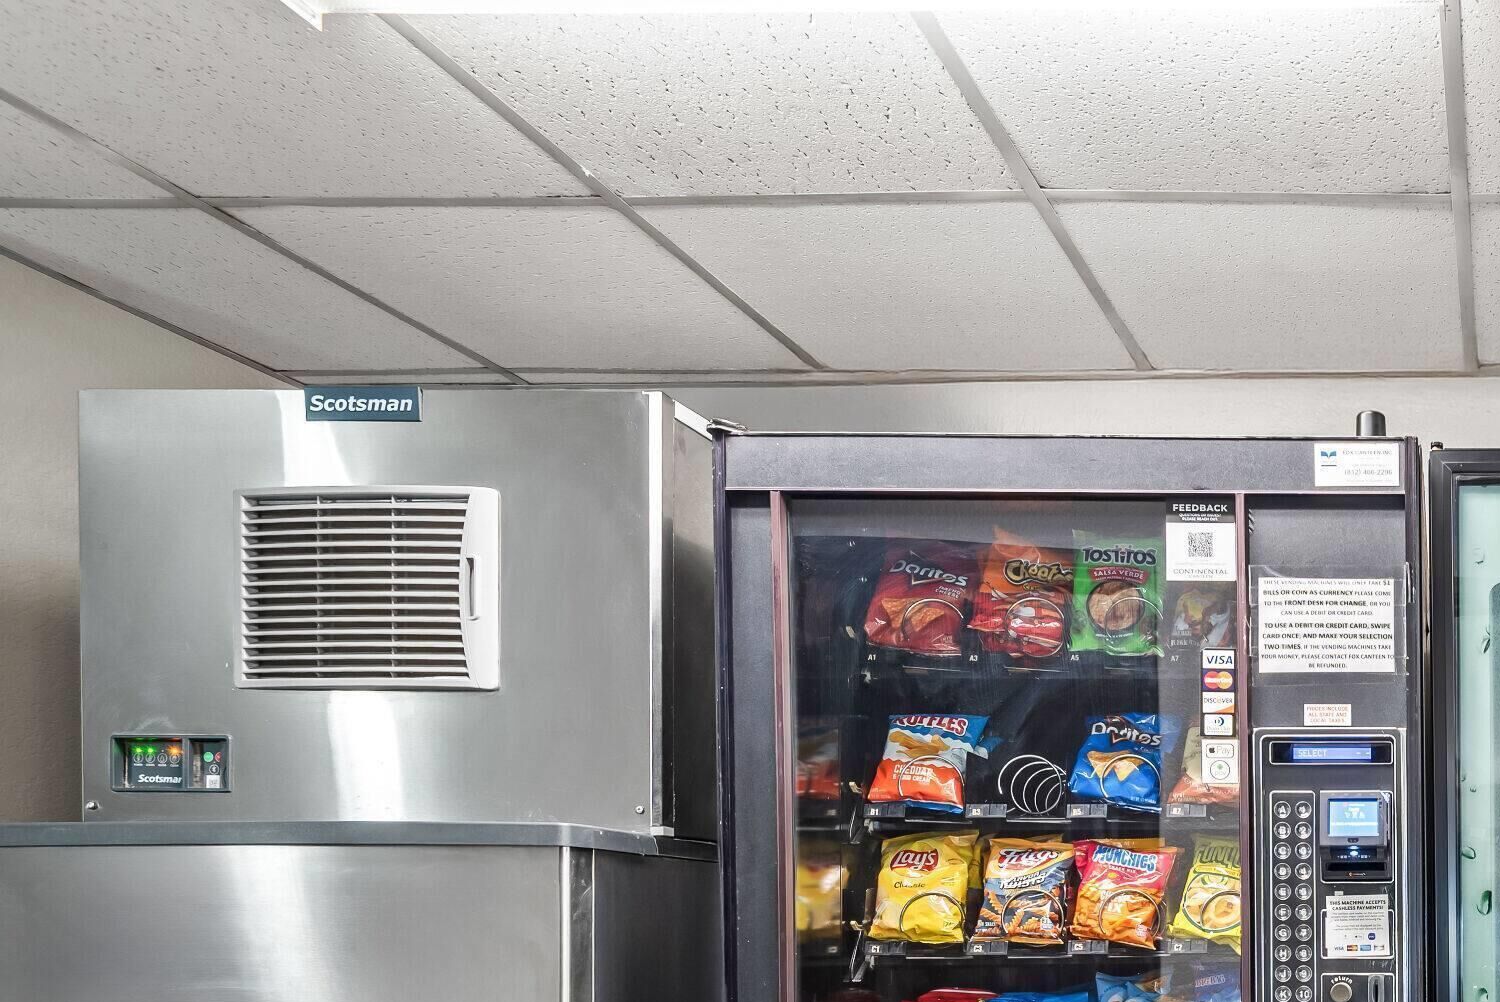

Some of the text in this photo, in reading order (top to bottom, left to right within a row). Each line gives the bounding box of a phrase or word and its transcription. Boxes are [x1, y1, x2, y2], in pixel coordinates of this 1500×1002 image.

[309, 394, 413, 412] Scotsman
[1172, 503, 1228, 512] FEEDBACK
[889, 560, 969, 587] Doritos
[1093, 569, 1145, 579] SALSA VERDE
[1274, 622, 1287, 630] USE
[1294, 622, 1313, 630] DEBIT
[1325, 622, 1348, 630] CREDIT
[1370, 622, 1390, 630] SWIPE
[868, 654, 876, 662] A1
[969, 654, 978, 662] A3
[1070, 654, 1080, 662] A5
[1206, 655, 1233, 665] VISA
[1298, 749, 1328, 757] SELECT
[892, 849, 937, 870] Lay's
[1093, 845, 1159, 873] MUNCHIES
